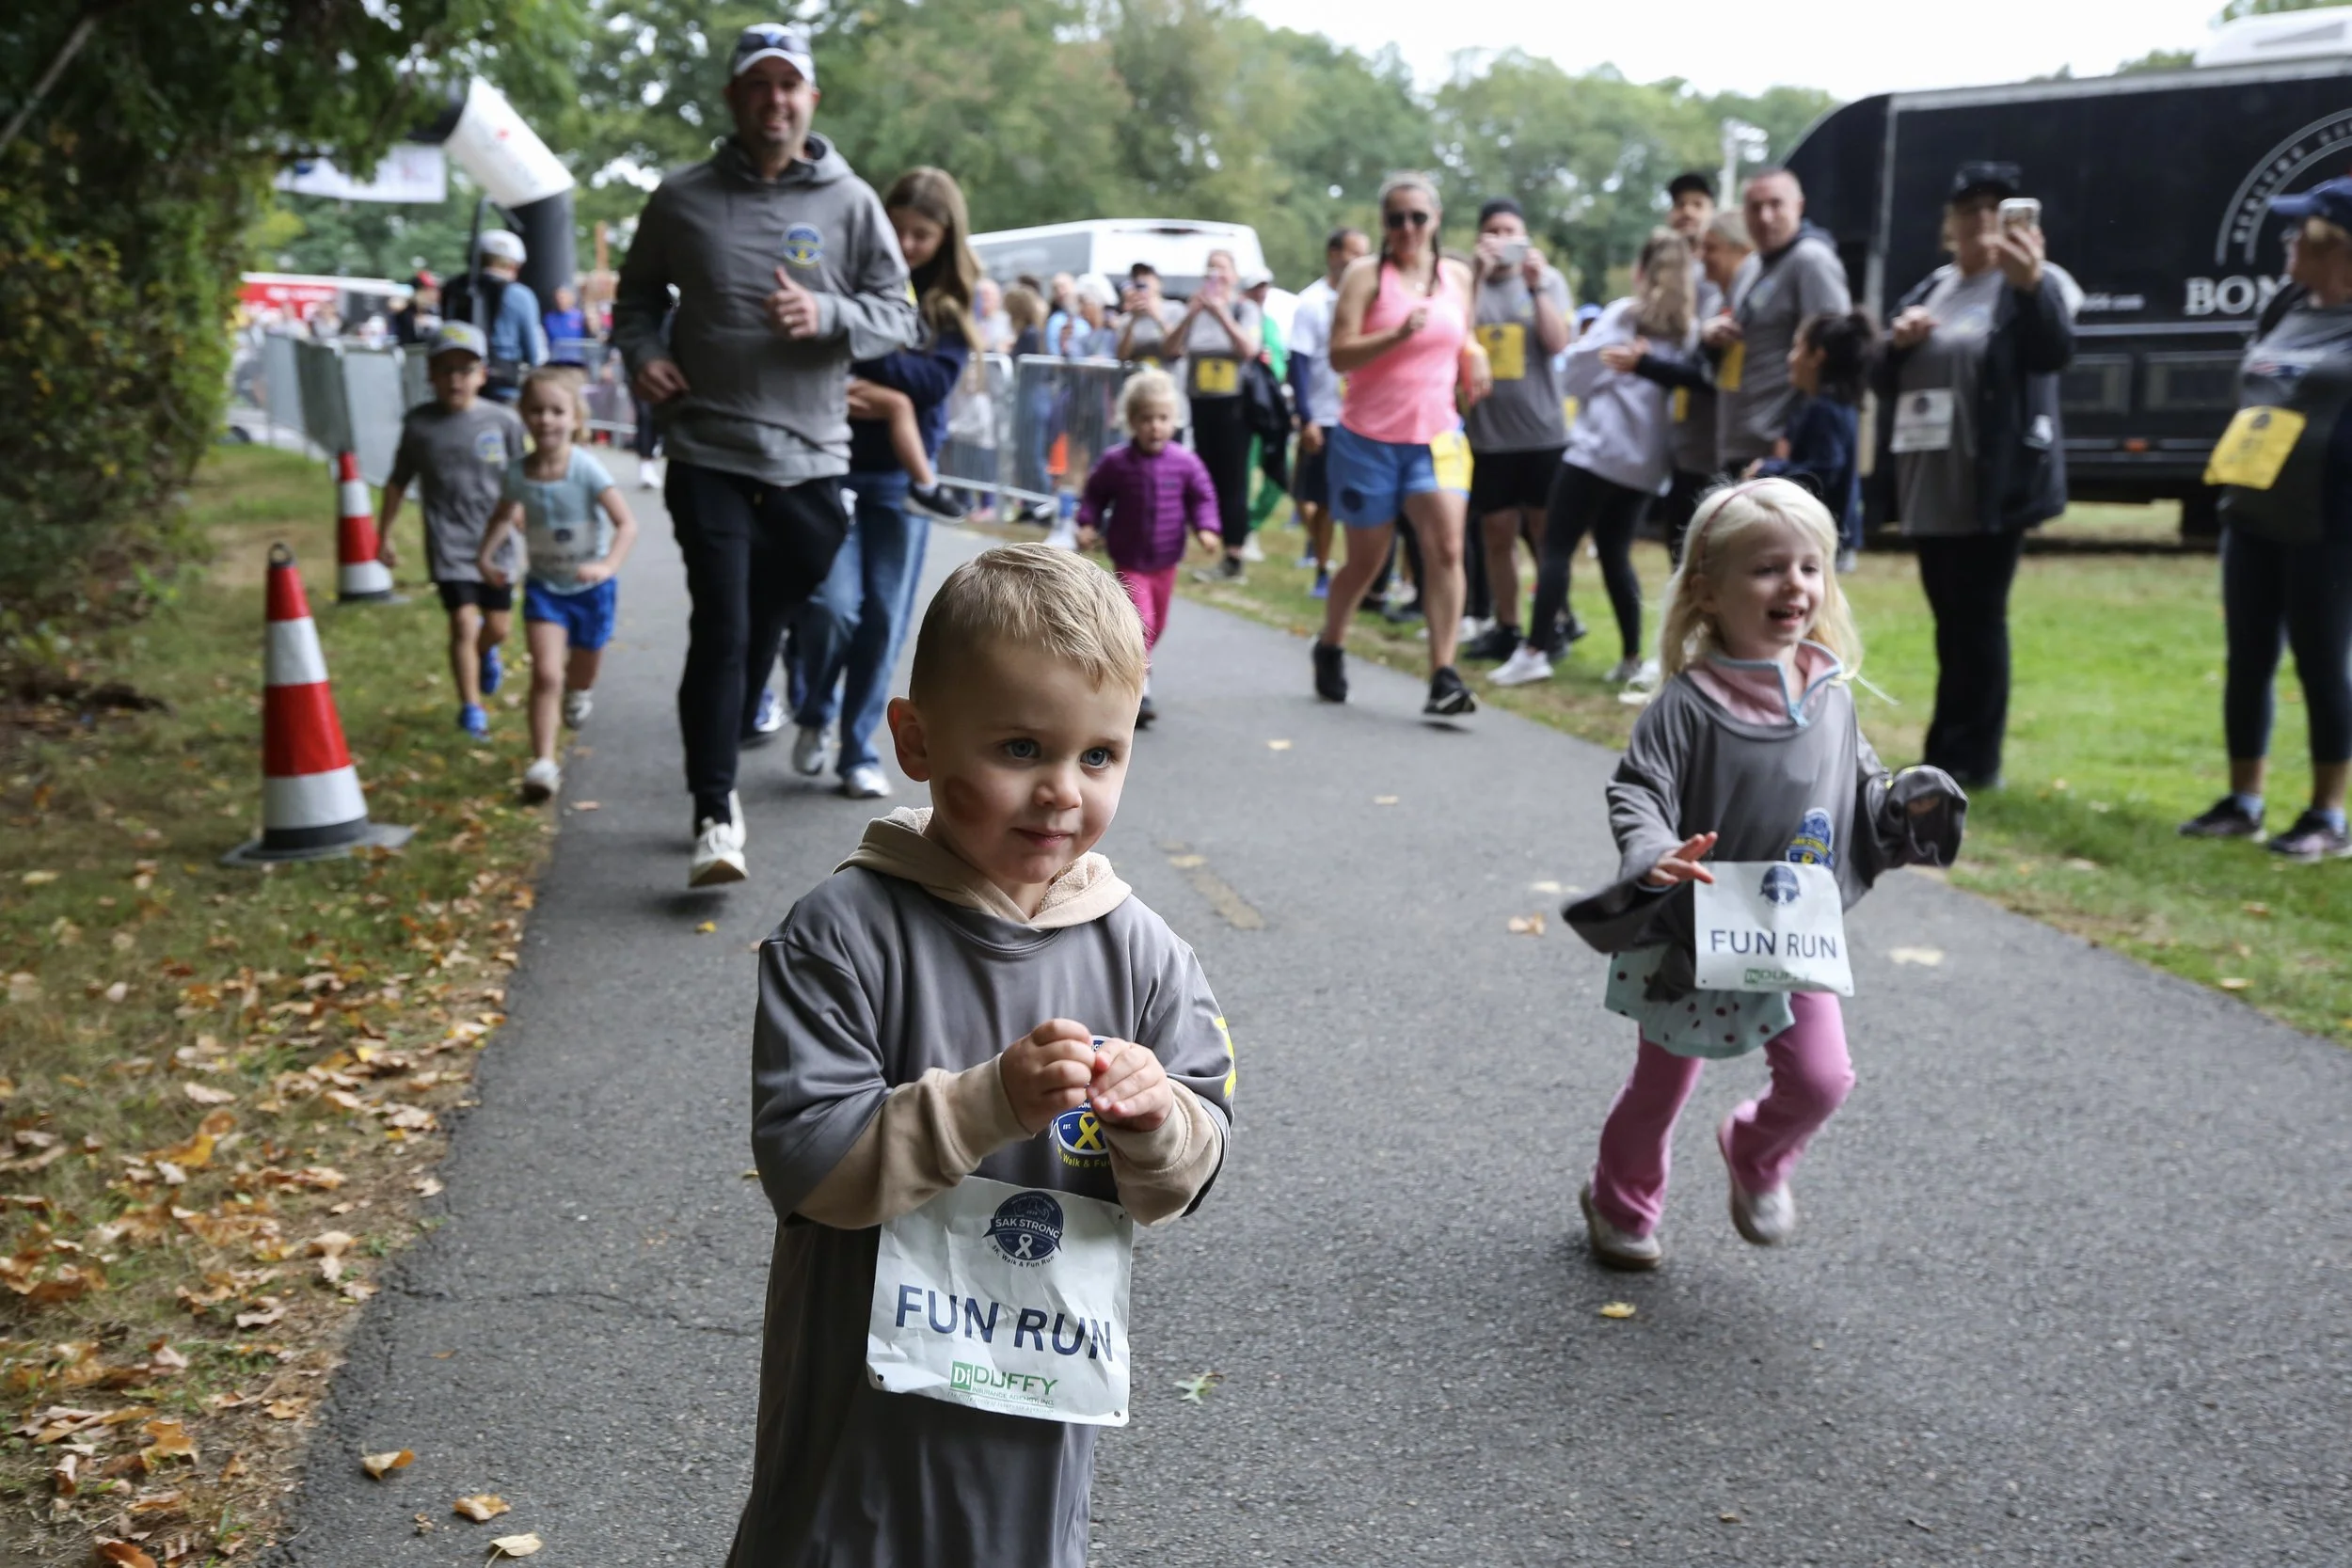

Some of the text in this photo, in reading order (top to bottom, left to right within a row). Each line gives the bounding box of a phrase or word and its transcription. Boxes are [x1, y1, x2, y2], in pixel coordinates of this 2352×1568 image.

[1710, 929, 1837, 958] FUN RUN
[1063, 1153, 1080, 1167] Walk
[995, 1218, 1017, 1227] SAK
[1019, 1219, 1059, 1239] STRONG
[1002, 1254, 1016, 1265] Walk
[1041, 1256, 1055, 1265] Run
[896, 1284, 1113, 1362] FUN RUN
[974, 1365, 1058, 1396] DUFFY
